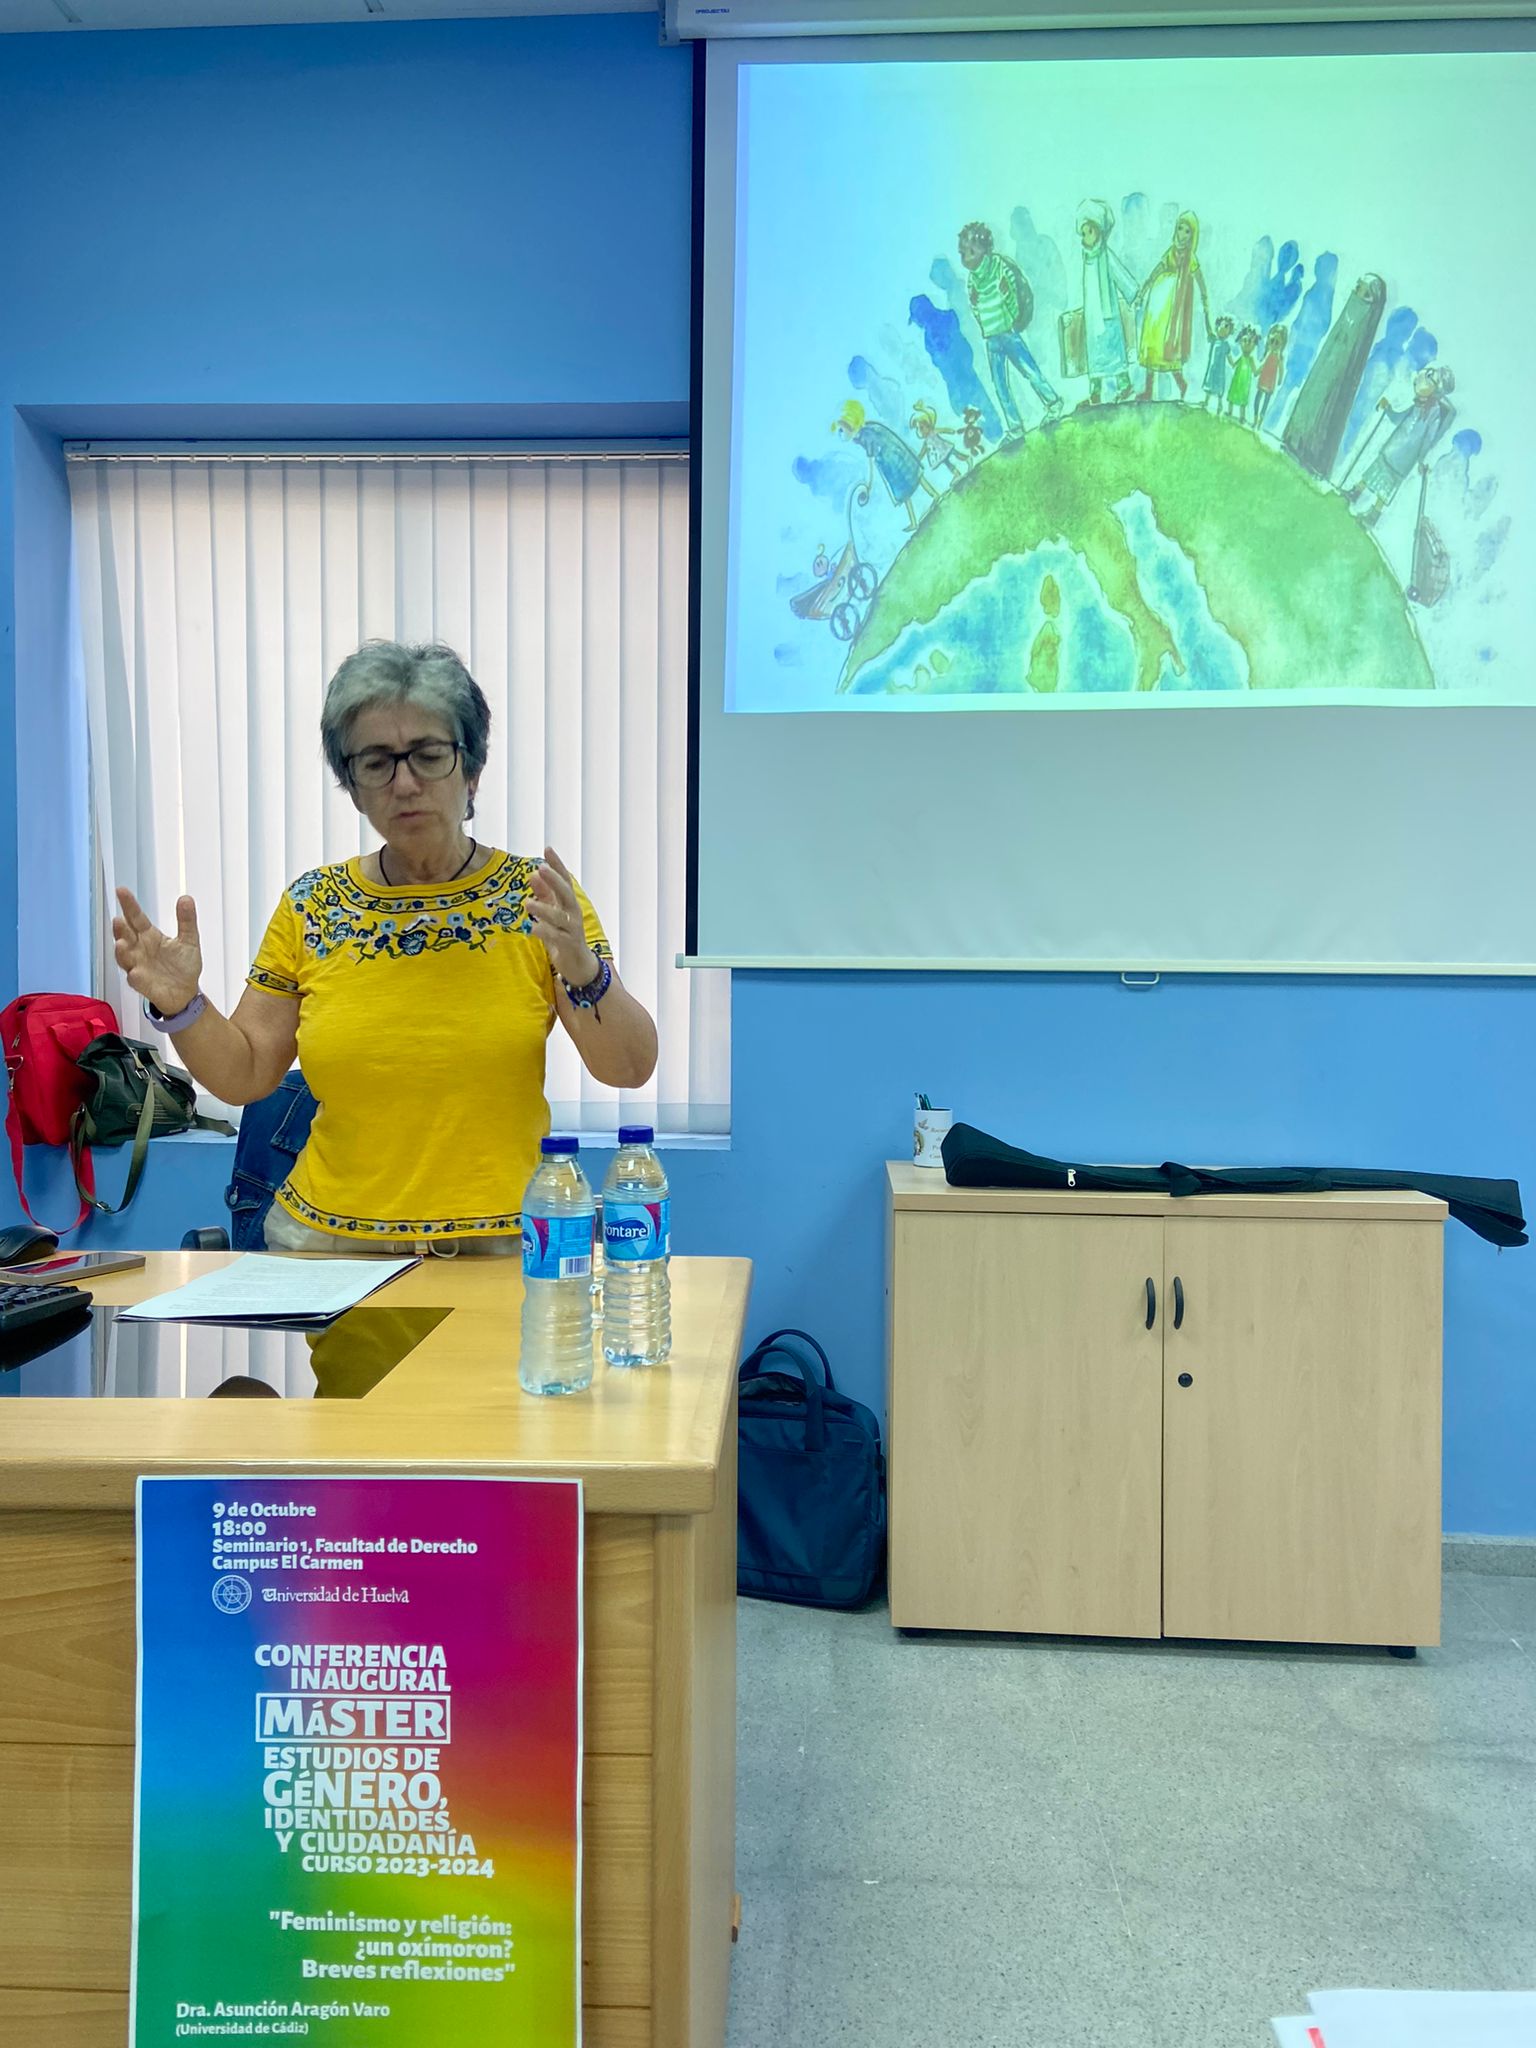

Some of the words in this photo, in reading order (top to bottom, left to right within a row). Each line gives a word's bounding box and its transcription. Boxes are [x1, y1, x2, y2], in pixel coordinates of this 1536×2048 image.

[213, 1502, 224, 1518] 9
[228, 1502, 248, 1517] de
[250, 1502, 316, 1517] Octubre
[213, 1520, 267, 1536] 18:00
[213, 1538, 298, 1553] Seminario
[300, 1540, 313, 1555] 1,
[316, 1538, 385, 1553] Facultad
[388, 1538, 408, 1553] de
[411, 1539, 477, 1554] Derecho
[213, 1556, 278, 1573] Campus
[282, 1555, 298, 1569] El
[301, 1556, 363, 1570] Carmen
[262, 1587, 339, 1602] Universidad
[342, 1588, 359, 1602] de
[361, 1587, 409, 1603] Huelva
[255, 1644, 447, 1668] CONFERENCIA
[291, 1668, 451, 1691] INAUGURAL
[264, 1699, 445, 1737] MÁSTER
[264, 1747, 399, 1770] ESTUDIOS
[403, 1748, 439, 1770] DE
[263, 1771, 449, 1809] GÉNERO,
[265, 1808, 450, 1831] IDENTIDADES
[275, 1832, 293, 1852] Y
[300, 1829, 475, 1856] CIUDADANÍA
[302, 1855, 372, 1873] CURSO
[376, 1857, 494, 1878] 2023-2024
[270, 1911, 400, 1932] "Feminismo
[403, 1918, 416, 1936] y
[421, 1914, 513, 1939] religión:
[355, 1940, 394, 1960] ¿un
[398, 1939, 513, 1958] oxímoron?
[303, 1960, 376, 1978] Breves
[380, 1960, 515, 1981] reflexiones"
[176, 2002, 211, 2018] Dra.
[214, 2001, 288, 2018] Asunción
[291, 2001, 349, 2020] Aragón
[352, 2003, 390, 2017] Varo
[176, 2021, 253, 2036] (Universidad
[254, 2022, 269, 2034] de
[271, 2021, 309, 2035] Cádiz)
